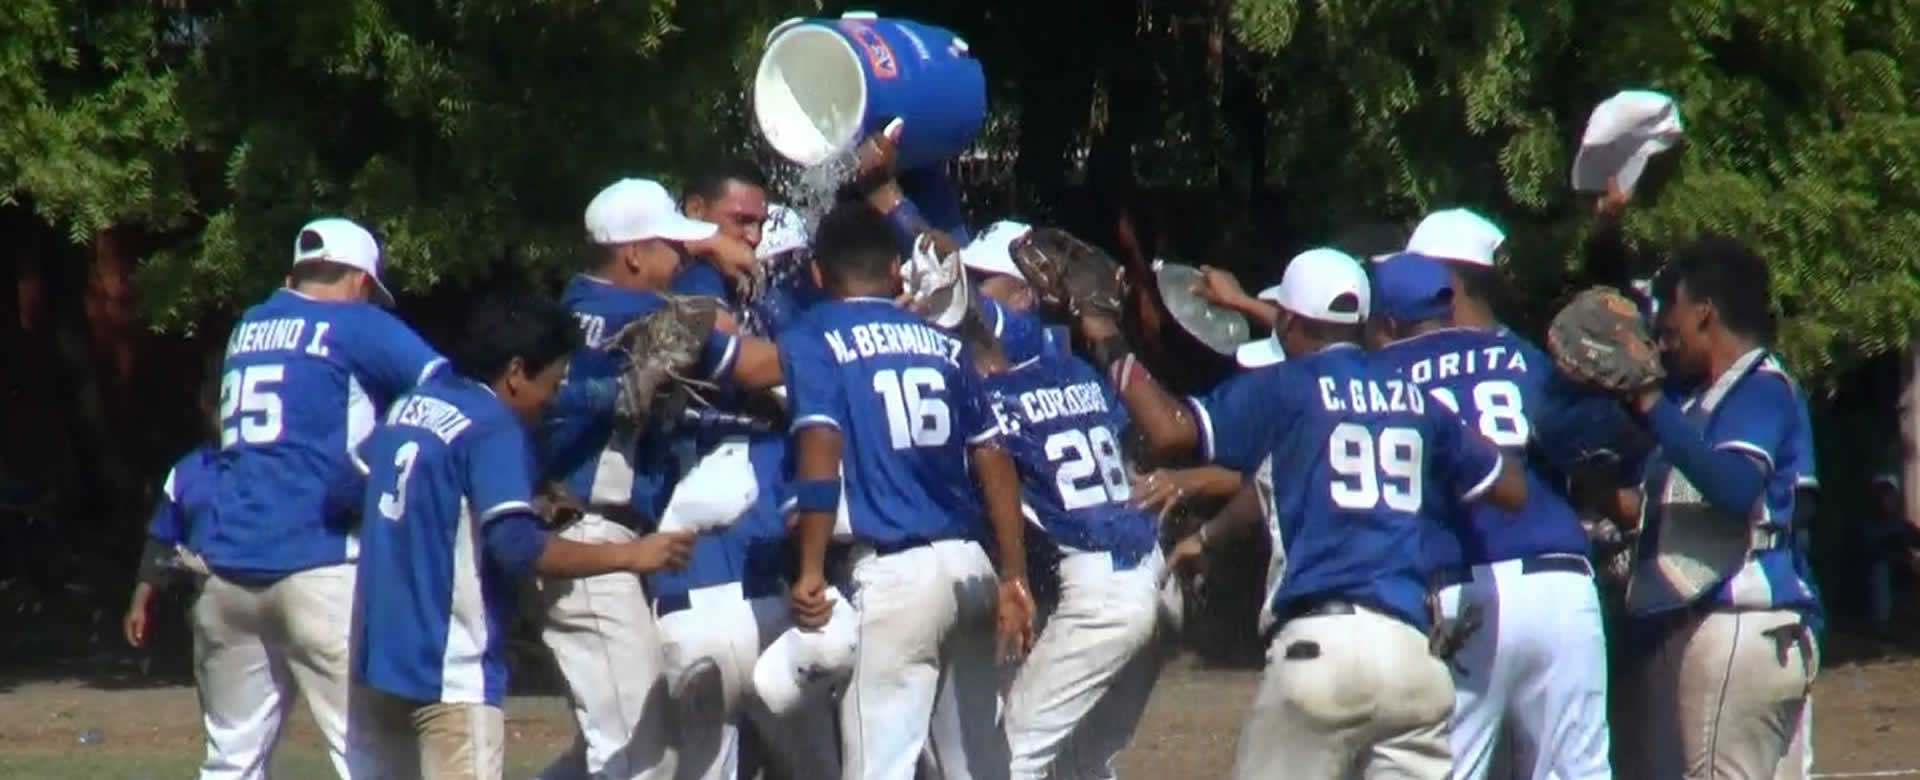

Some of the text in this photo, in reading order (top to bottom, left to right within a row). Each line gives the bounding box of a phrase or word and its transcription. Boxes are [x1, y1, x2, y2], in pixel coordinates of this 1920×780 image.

[221, 364, 285, 447] 25
[1397, 345, 1528, 384] ORITA
[873, 367, 951, 450] 16
[378, 440, 420, 521] 3
[1045, 425, 1131, 511] 28
[1329, 422, 1424, 513] 99
